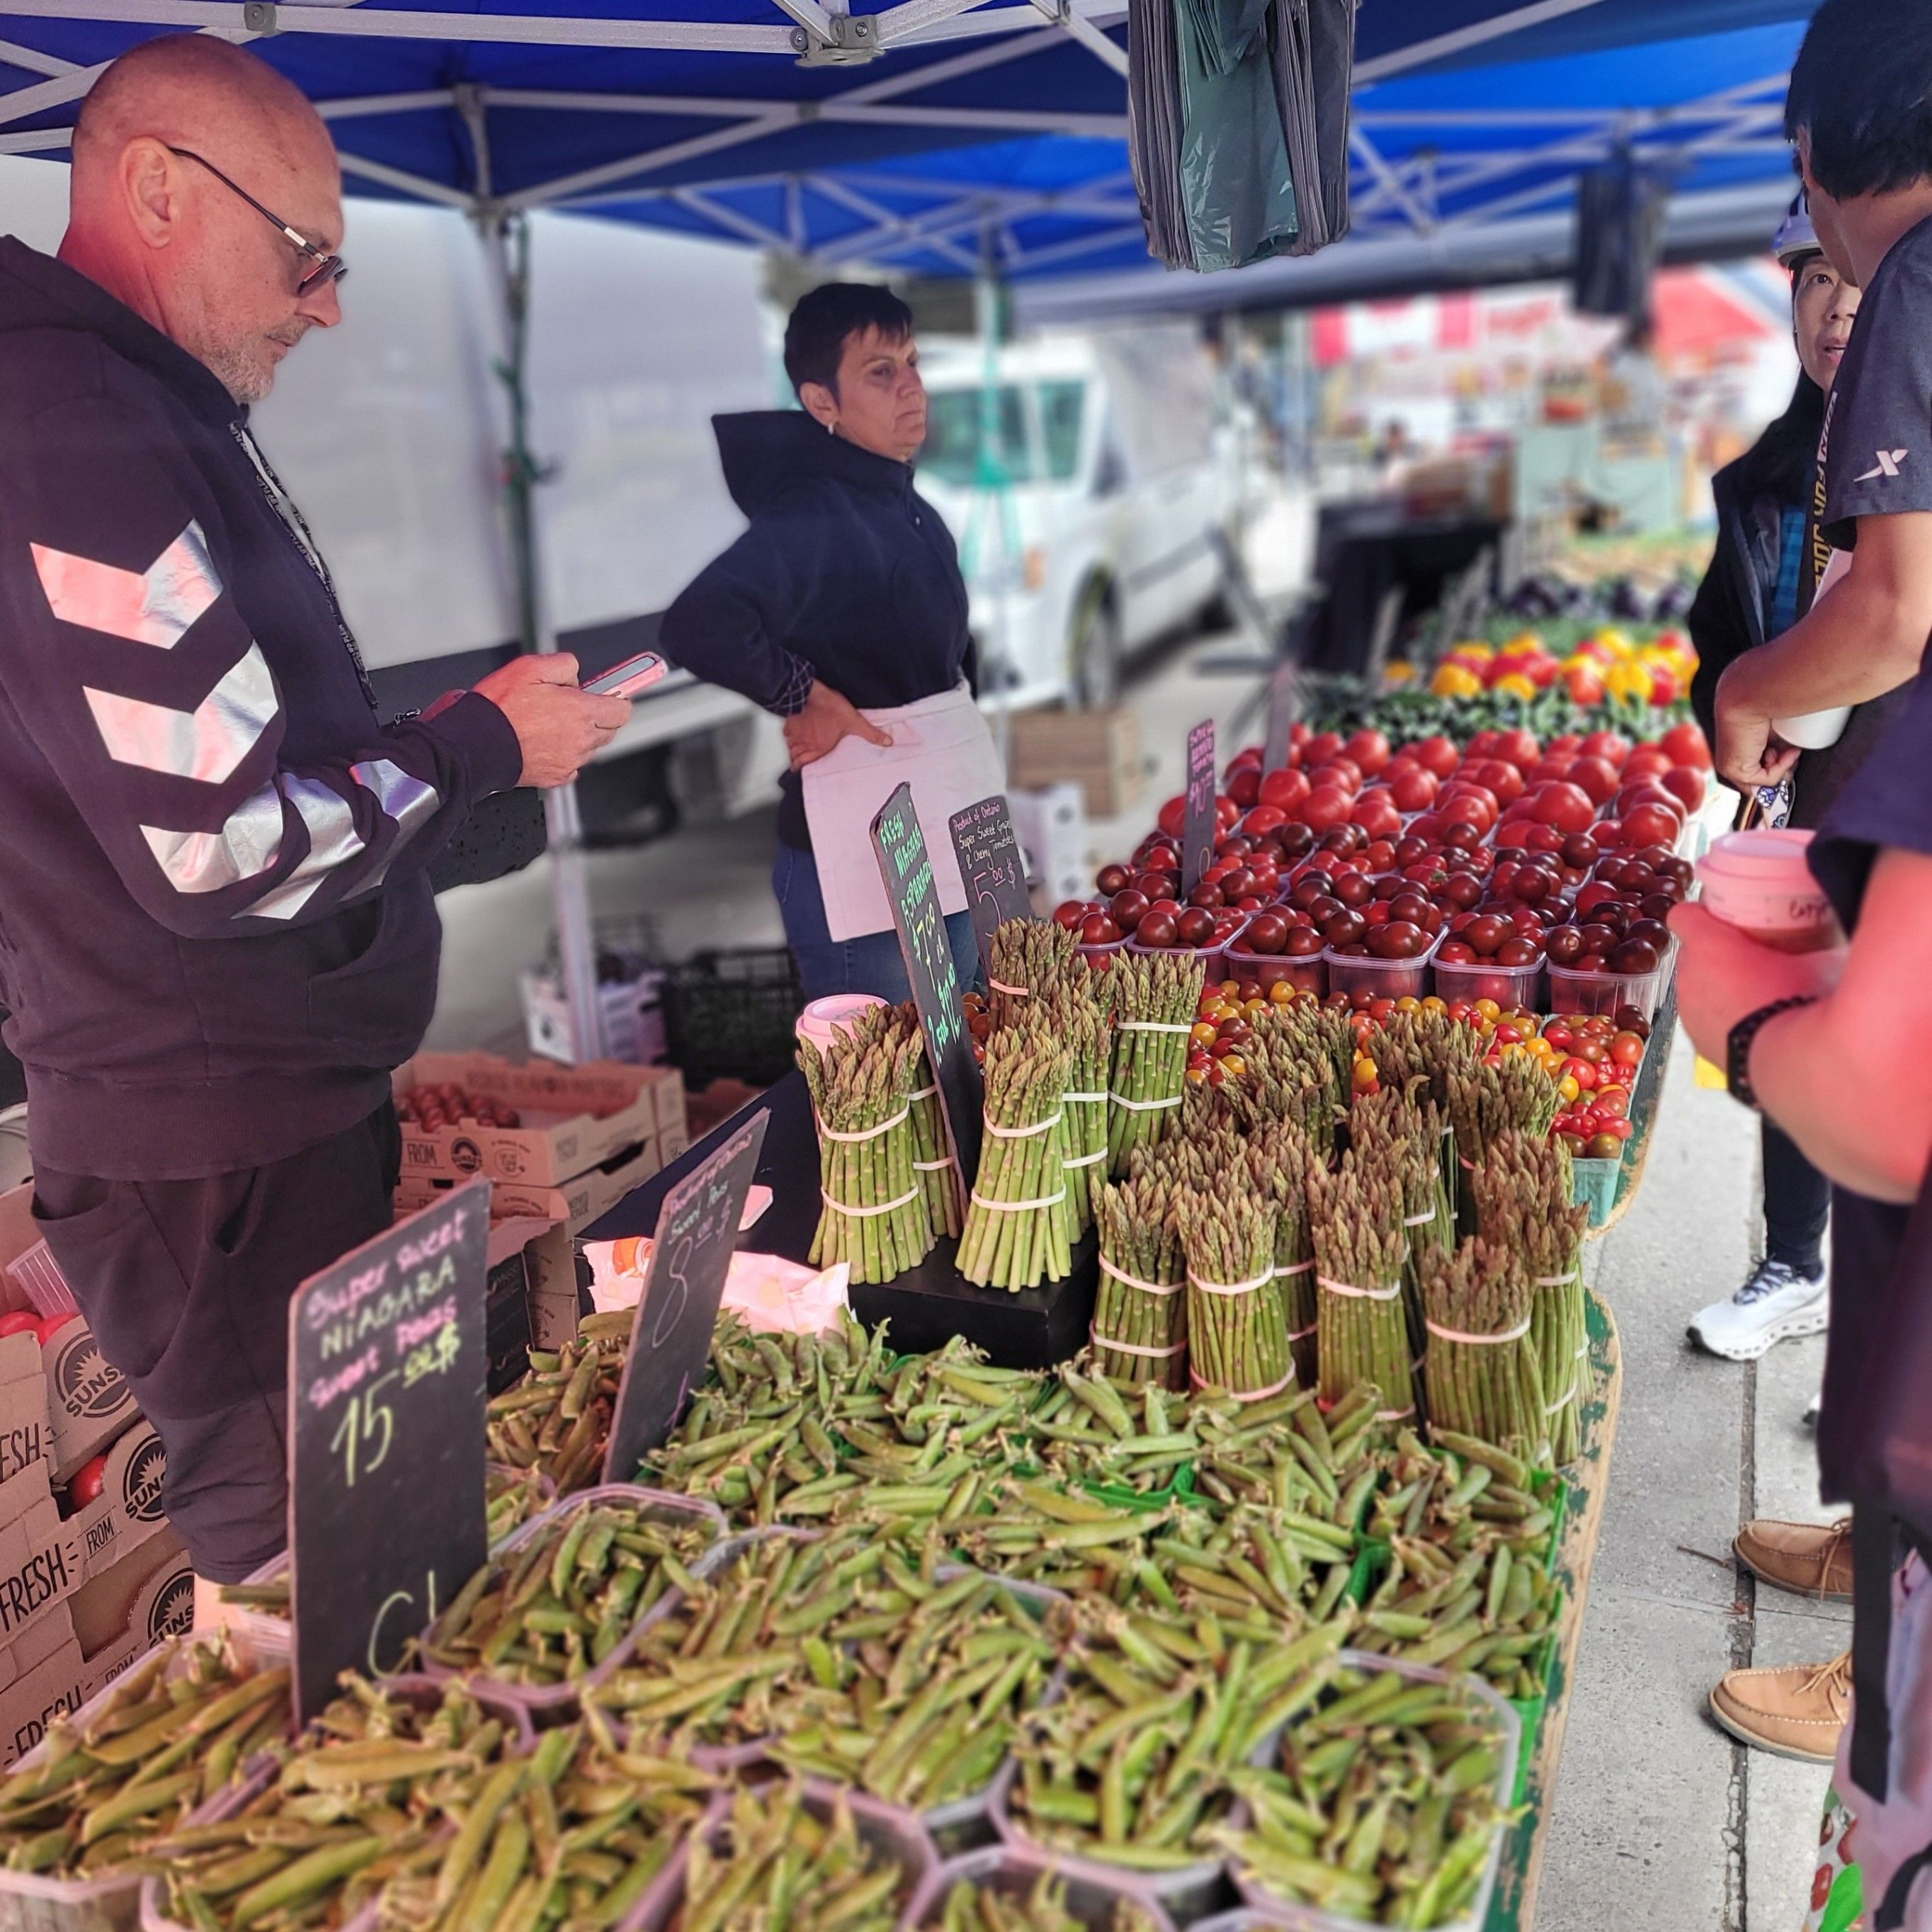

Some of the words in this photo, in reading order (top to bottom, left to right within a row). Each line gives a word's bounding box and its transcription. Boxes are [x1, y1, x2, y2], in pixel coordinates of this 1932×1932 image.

[880, 810, 904, 853] FRESH
[953, 812, 972, 832] Product
[974, 809, 981, 824] of
[982, 802, 1000, 819] Ontario
[894, 823, 923, 880] NIAGARA
[959, 834, 975, 854] Super
[977, 826, 996, 840] Sweet
[989, 834, 1013, 852] Tomatoes
[407, 1142, 438, 1166] FROM
[653, 1236, 693, 1348] 8
[66, 1365, 124, 1417] SUNS
[330, 1368, 400, 1487] 15
[86, 1516, 115, 1555] FROM
[0, 1543, 68, 1632] FRESH
